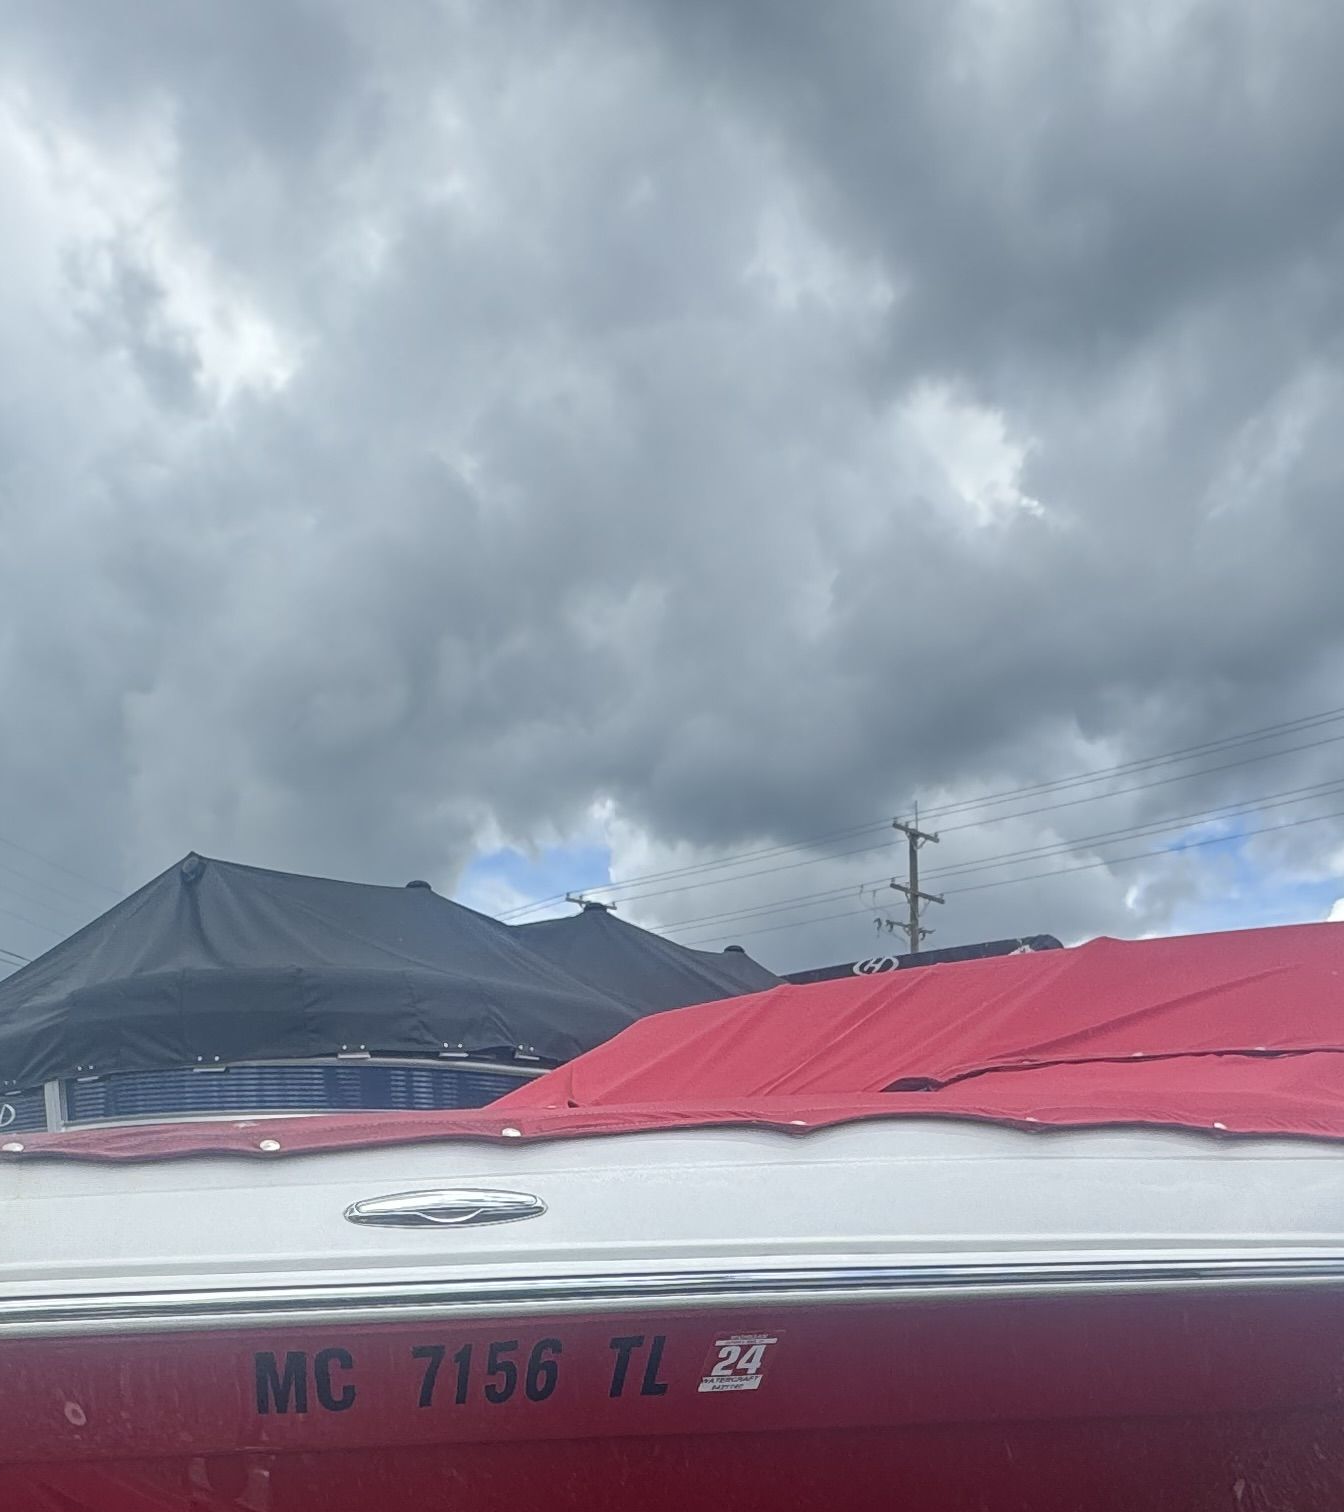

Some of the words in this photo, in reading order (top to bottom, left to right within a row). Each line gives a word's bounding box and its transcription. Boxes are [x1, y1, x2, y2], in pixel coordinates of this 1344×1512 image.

[255, 1347, 357, 1414] MC
[411, 1337, 563, 1408] 7156
[609, 1335, 668, 1399] TL
[711, 1345, 767, 1375] 24
